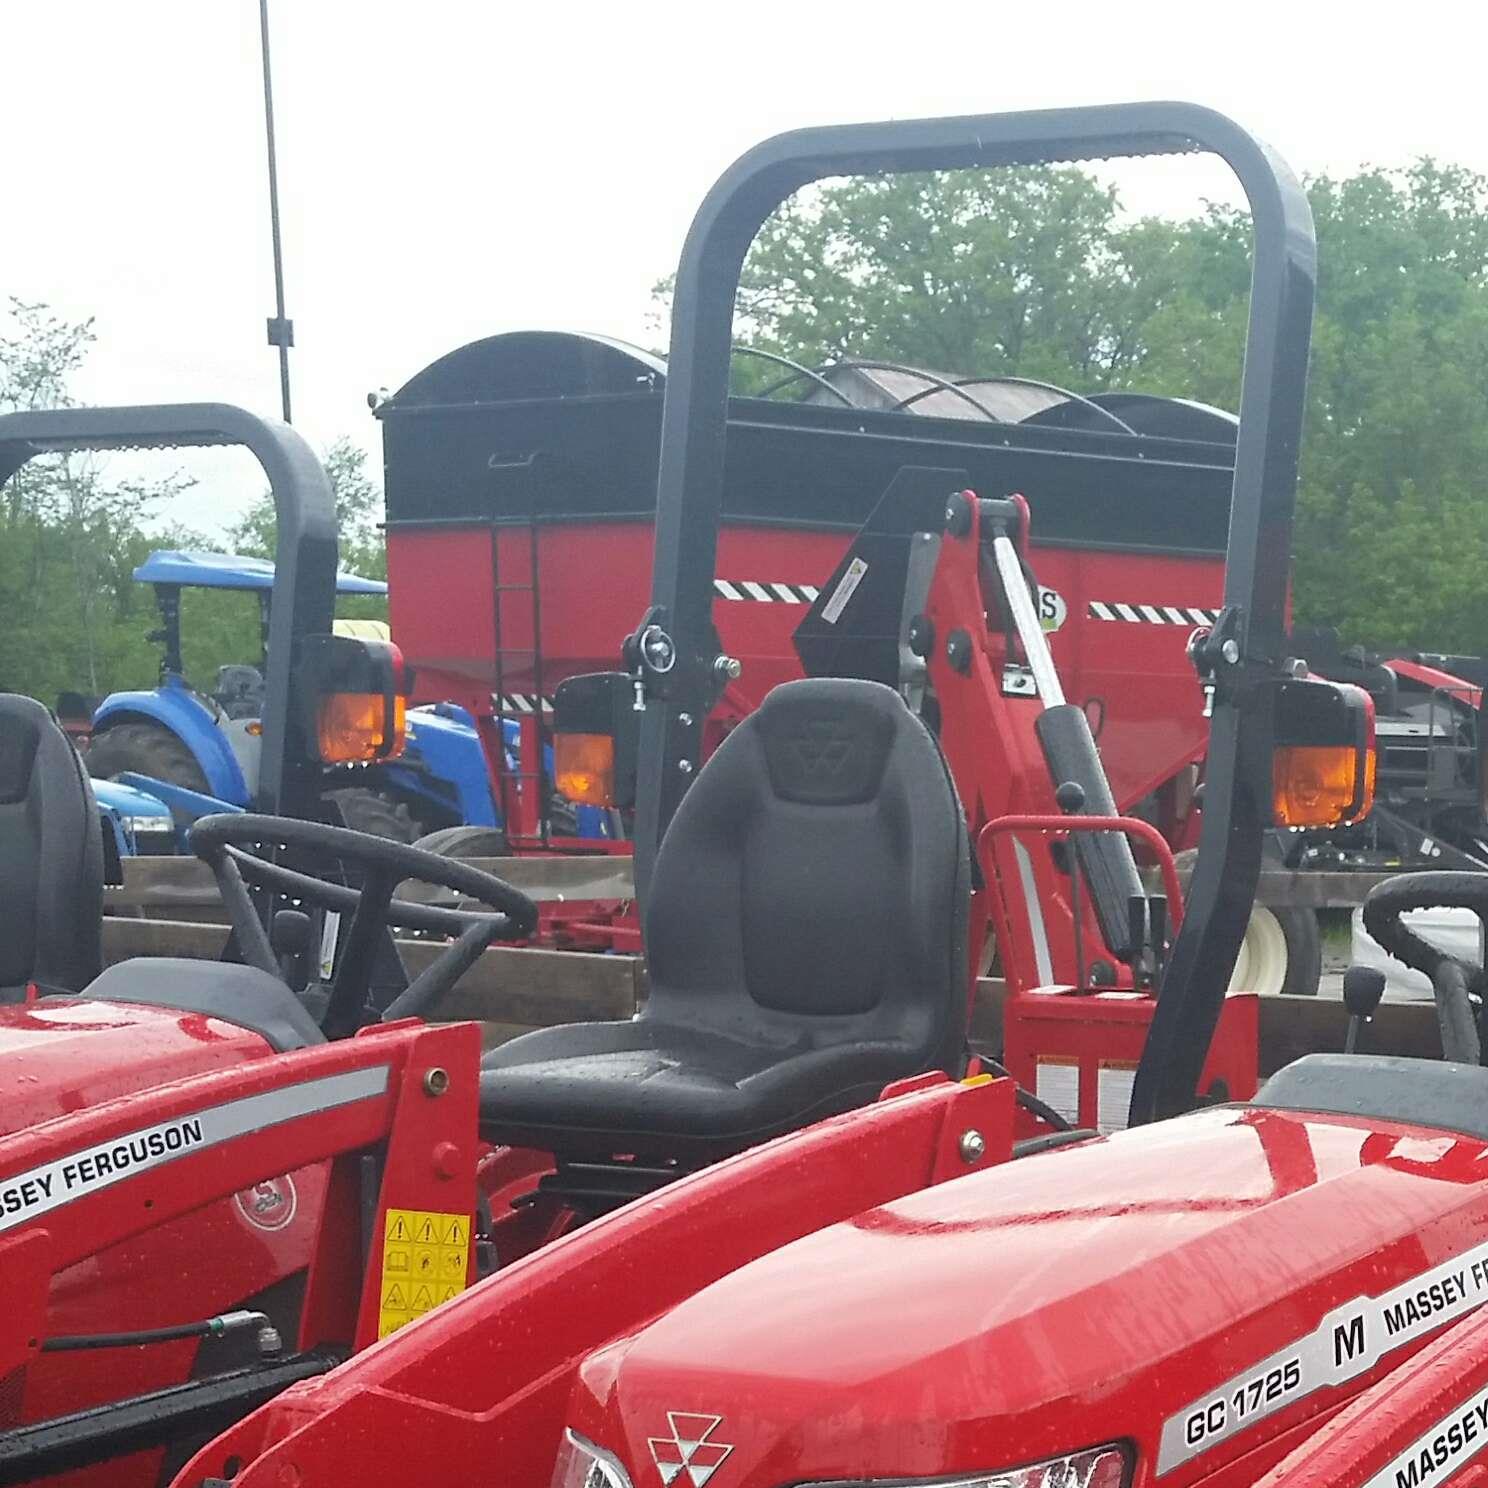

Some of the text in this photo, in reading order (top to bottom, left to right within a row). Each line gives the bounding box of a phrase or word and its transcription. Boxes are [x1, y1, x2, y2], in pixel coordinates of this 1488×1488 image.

[0, 1119, 203, 1218] SEY FERGUSON
[1186, 1400, 1225, 1444] GC
[1233, 1358, 1301, 1418] 1725
[1333, 1315, 1365, 1367] M
[1383, 1272, 1466, 1336] MASSEY
